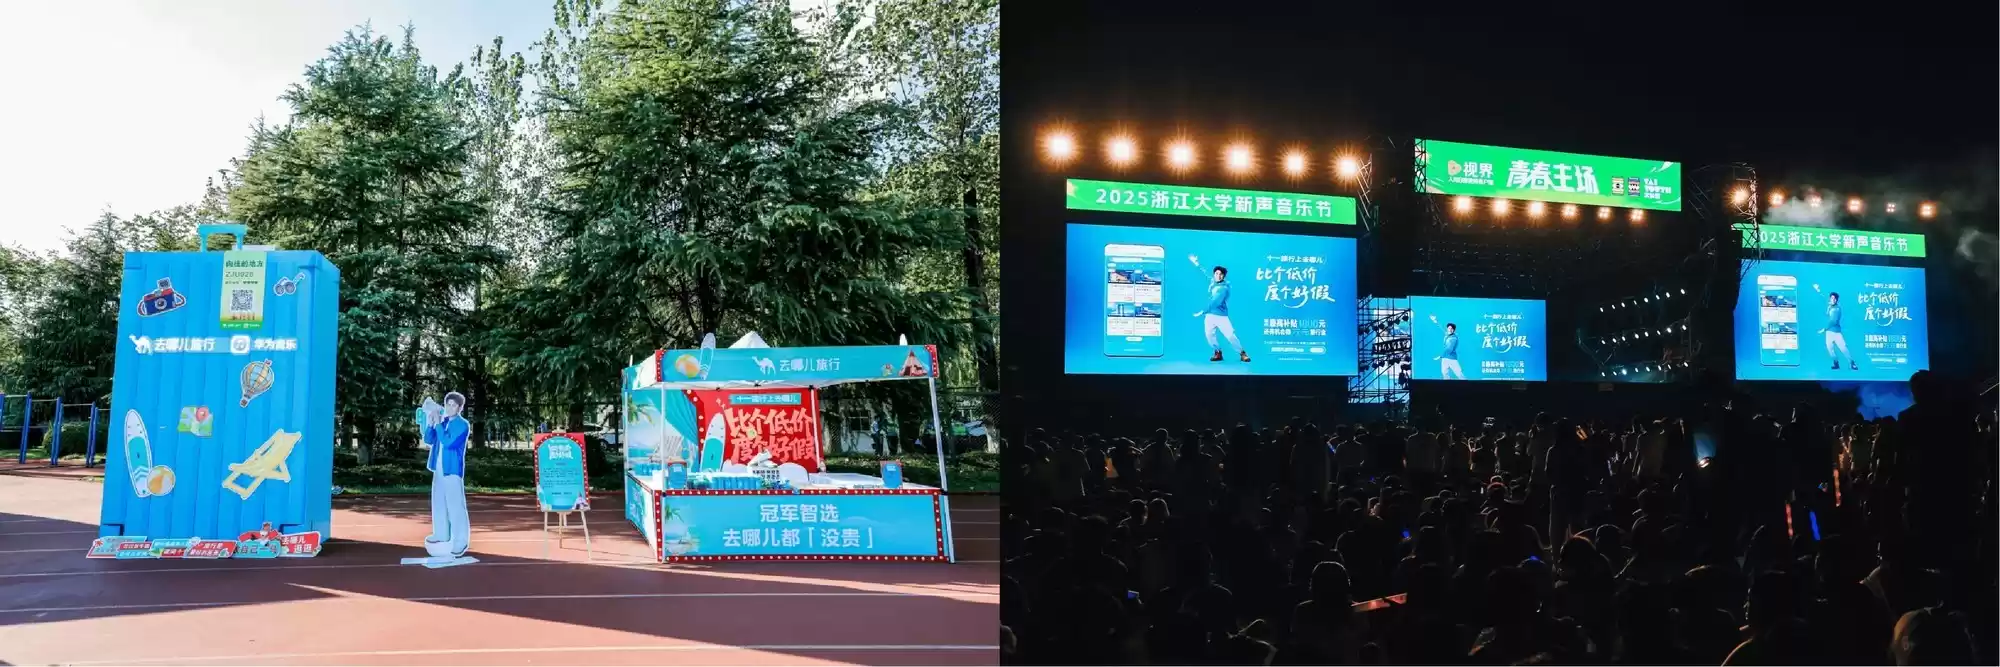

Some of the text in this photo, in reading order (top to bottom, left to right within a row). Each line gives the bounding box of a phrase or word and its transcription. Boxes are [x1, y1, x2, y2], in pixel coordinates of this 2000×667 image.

[1463, 161, 1494, 178] 视界
[1506, 159, 1600, 194] 青春主场
[1095, 188, 1333, 218] 2025浙江大学新声音乐节
[1256, 266, 1317, 285] 比个低价
[1264, 282, 1335, 308] 度个好假
[1857, 292, 1899, 307] 比个低价
[1864, 305, 1912, 326] 度个好假
[1475, 322, 1517, 335] 比个低价
[154, 337, 216, 351] 去哪儿旅行
[254, 338, 297, 351] 华为音乐
[1482, 333, 1531, 353] 度个好假
[779, 357, 841, 372] 去哪儿旅行
[724, 407, 813, 438] 比个低价
[731, 434, 816, 464] 度个好假
[760, 503, 839, 523] 冠军智选
[281, 536, 306, 545] 去哪儿
[723, 527, 875, 549] 去哪儿都「没贵」
